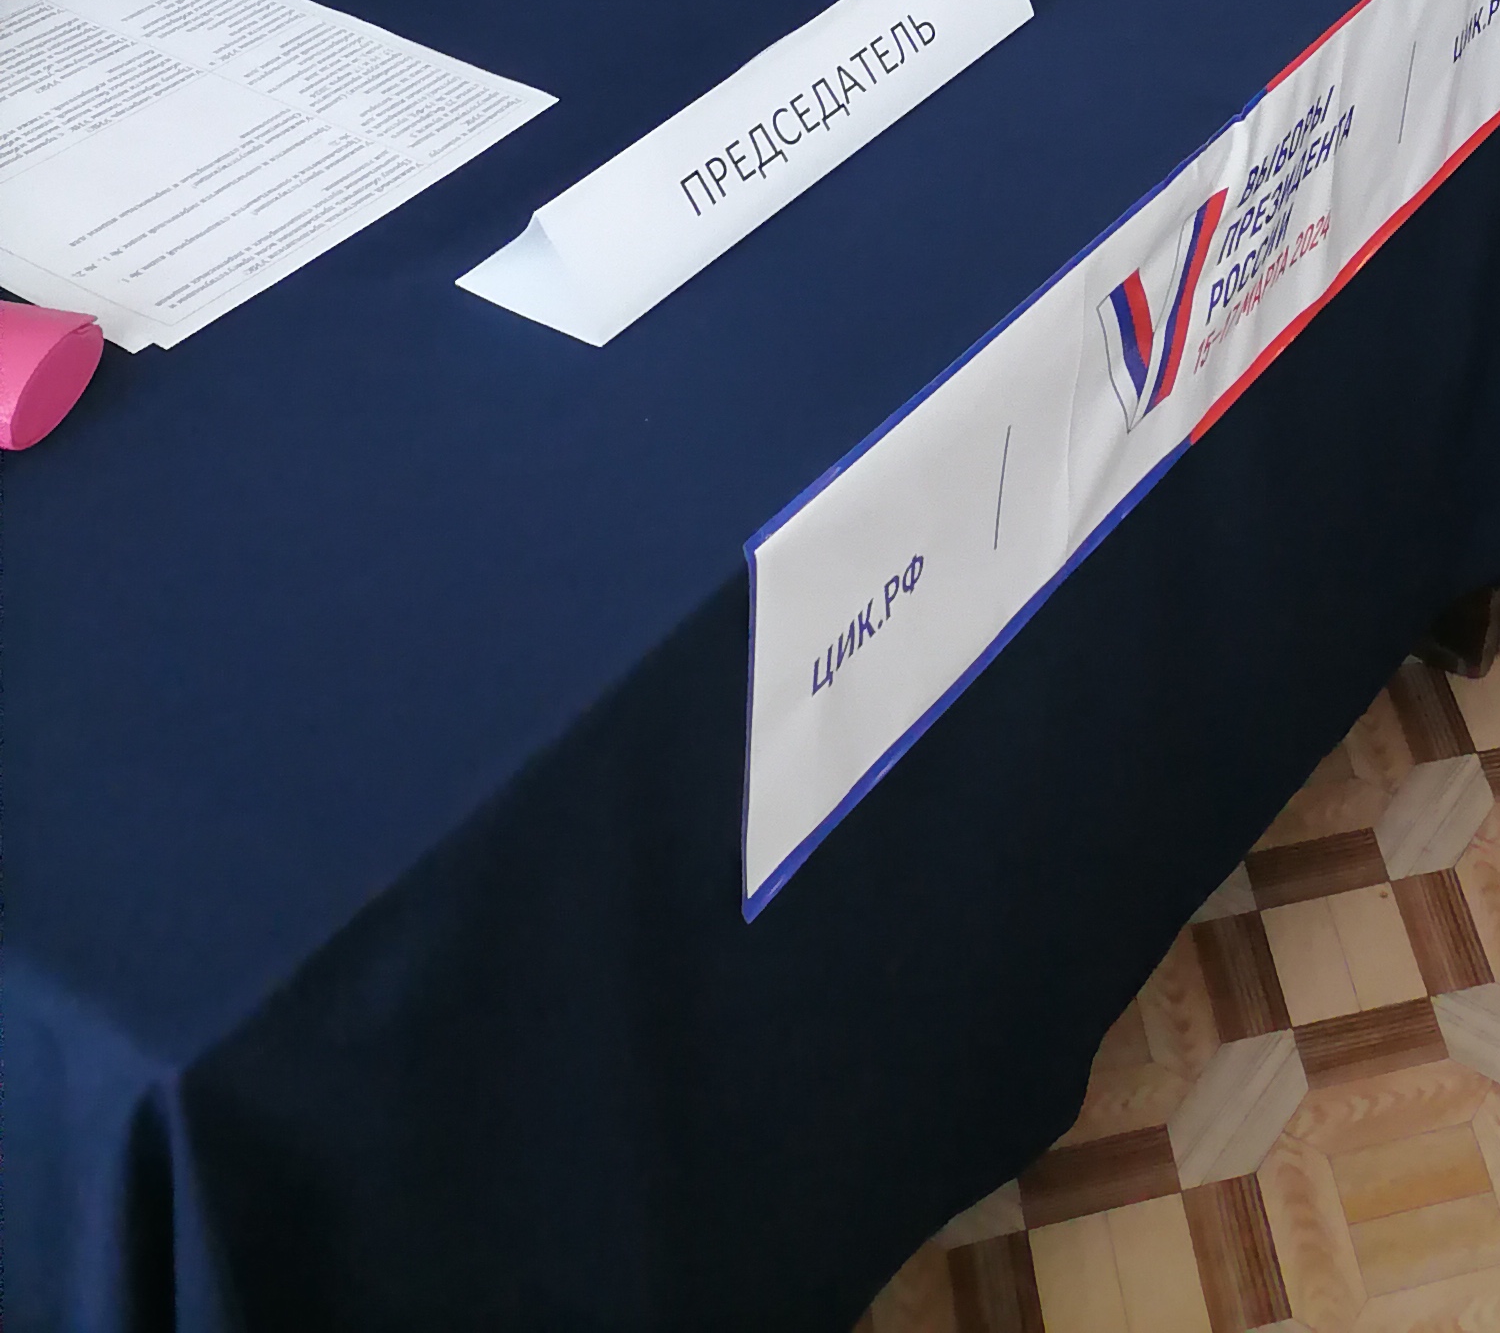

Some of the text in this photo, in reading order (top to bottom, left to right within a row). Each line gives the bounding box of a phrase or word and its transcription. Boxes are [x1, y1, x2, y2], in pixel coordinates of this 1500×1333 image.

[679, 13, 938, 217] ПРЕДСЕДАТЕЛЬ
[1237, 84, 1335, 208] ВЫБОРЫ
[1217, 104, 1355, 266] ПРЕЗИДЕНТА
[1205, 201, 1294, 327] РОССИИ
[1240, 245, 1290, 317] МАРТА
[1289, 213, 1331, 269] 2024
[812, 553, 924, 698] ЦИК.РФ
